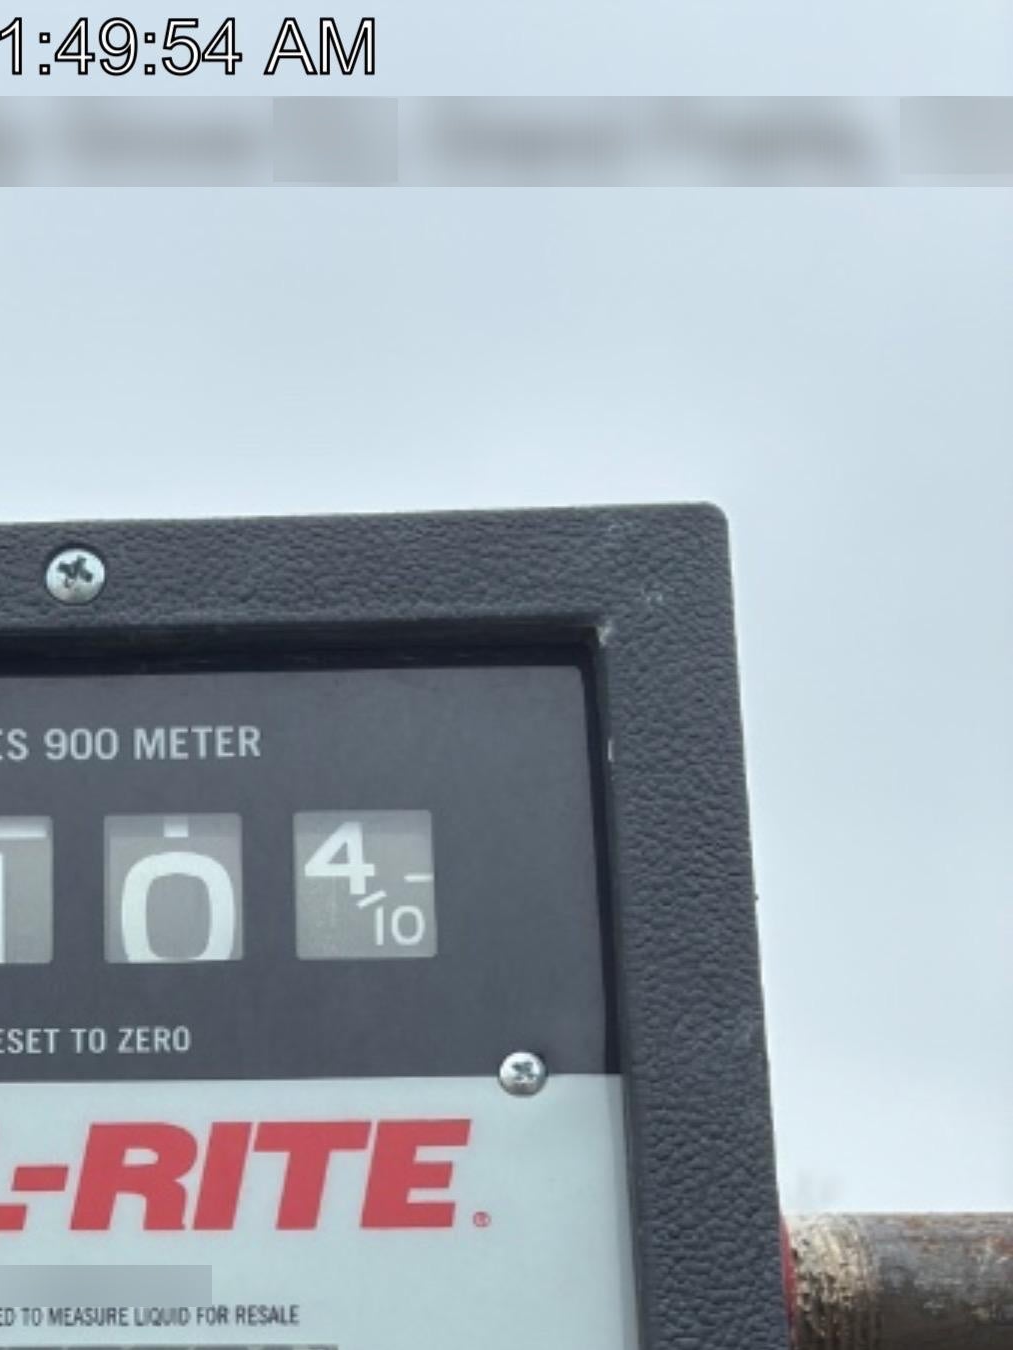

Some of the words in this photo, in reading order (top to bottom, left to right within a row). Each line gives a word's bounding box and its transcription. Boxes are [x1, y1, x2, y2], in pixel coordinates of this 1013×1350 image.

[43, 728, 120, 762] 900
[134, 725, 261, 760] METER
[70, 1027, 106, 1054] TO
[117, 1025, 191, 1053] ZERO
[20, 1307, 44, 1327] TO
[47, 1306, 129, 1327] MEASURE
[133, 1306, 191, 1327] LIQUID
[196, 1305, 229, 1326] FOR
[234, 1304, 300, 1326] RESALE
